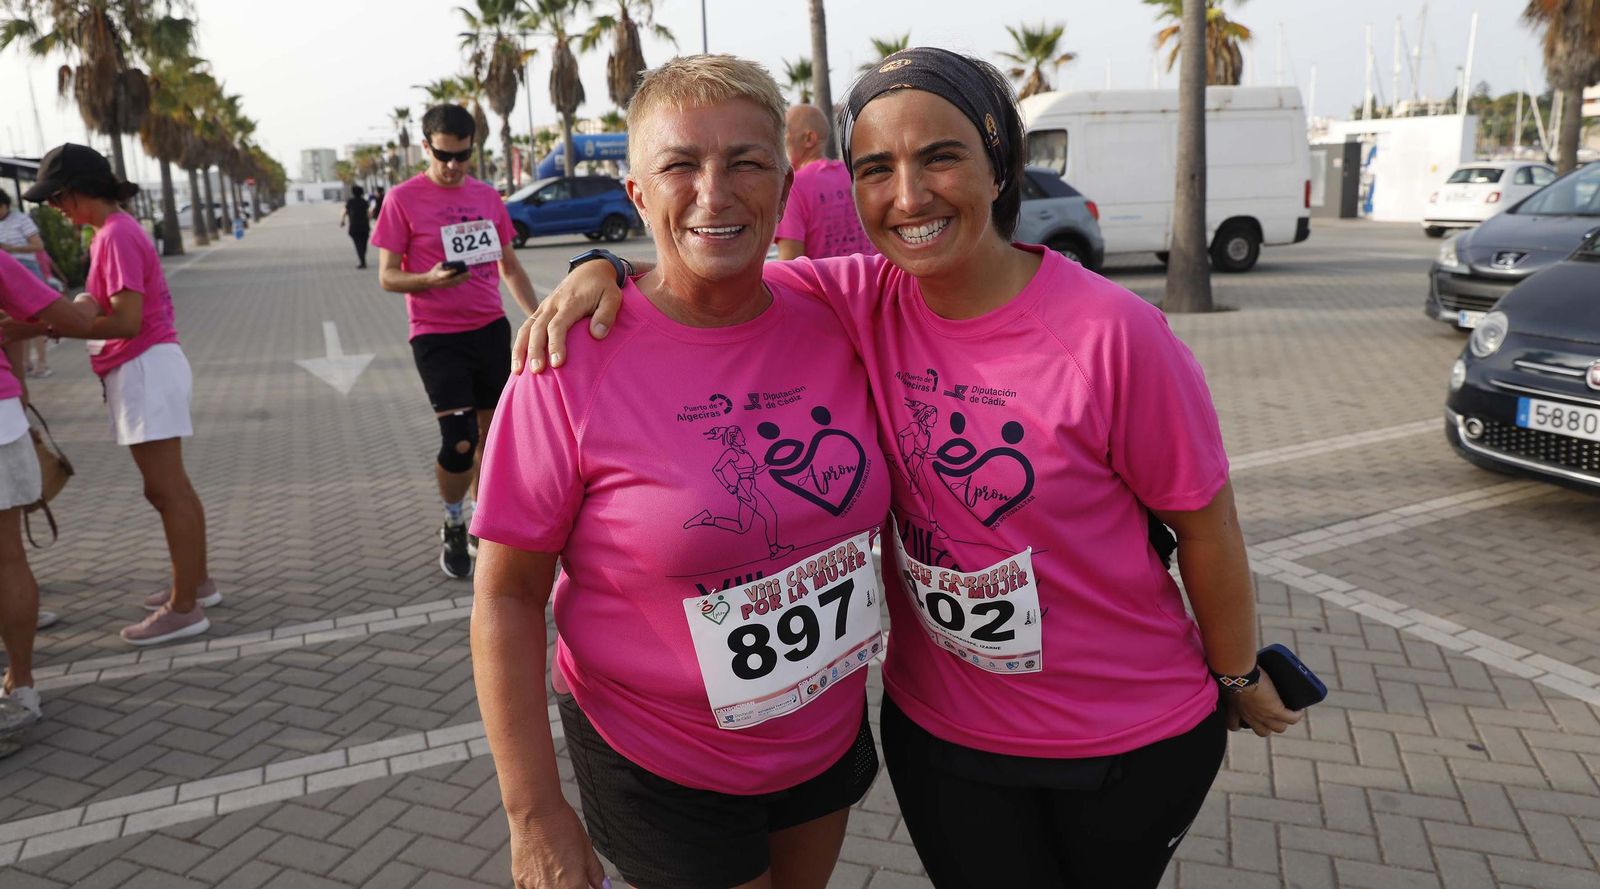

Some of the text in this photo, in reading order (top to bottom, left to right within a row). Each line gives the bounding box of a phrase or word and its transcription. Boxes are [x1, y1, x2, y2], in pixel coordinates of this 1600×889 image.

[452, 231, 492, 253] 824
[763, 385, 806, 401] Diputación
[765, 394, 802, 409] de Cádiz
[969, 395, 1006, 407] de Cádiz
[971, 385, 1017, 398] Diputación
[676, 411, 721, 423] Algeciras
[684, 404, 707, 412] Puerto
[1535, 404, 1598, 434] 5880
[797, 464, 857, 495] Apron
[950, 475, 1012, 508] Apron
[786, 541, 859, 587] CARRERA
[940, 560, 1021, 589] CARRERA
[740, 595, 783, 621] POR
[787, 581, 809, 604] LA
[812, 551, 867, 591] MUJER
[939, 580, 961, 596] LA
[968, 570, 1029, 599] MUJER
[727, 578, 855, 680] 897
